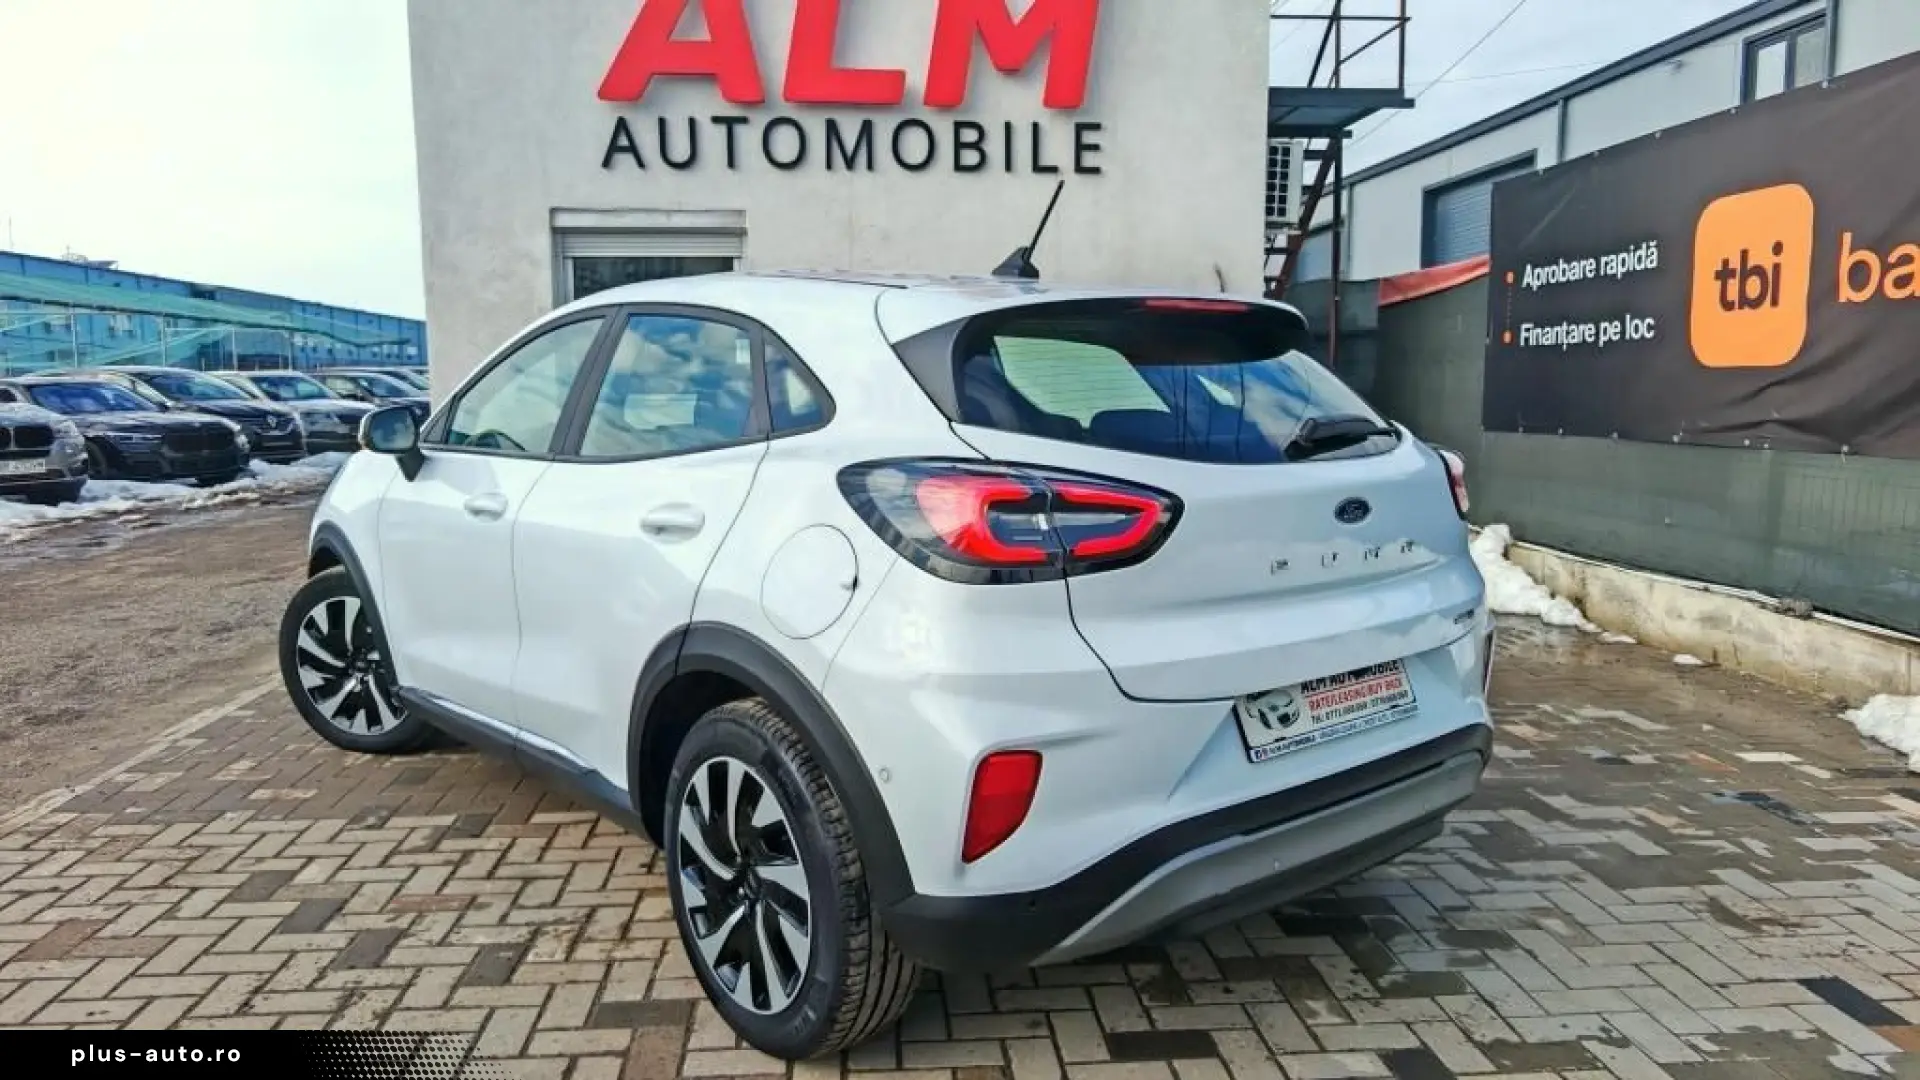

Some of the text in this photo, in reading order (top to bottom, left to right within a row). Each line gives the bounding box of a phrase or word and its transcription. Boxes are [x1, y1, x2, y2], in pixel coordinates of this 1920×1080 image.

[598, 0, 1100, 109] ALM
[601, 115, 1102, 174] AUTOMOBILE
[1521, 239, 1659, 290] Aprobare rapidă
[1714, 240, 1785, 312] tbi
[1838, 231, 1920, 303] ba
[1520, 314, 1655, 351] Finanțare pe loc
[1329, 660, 1399, 686] AUTOBILE
